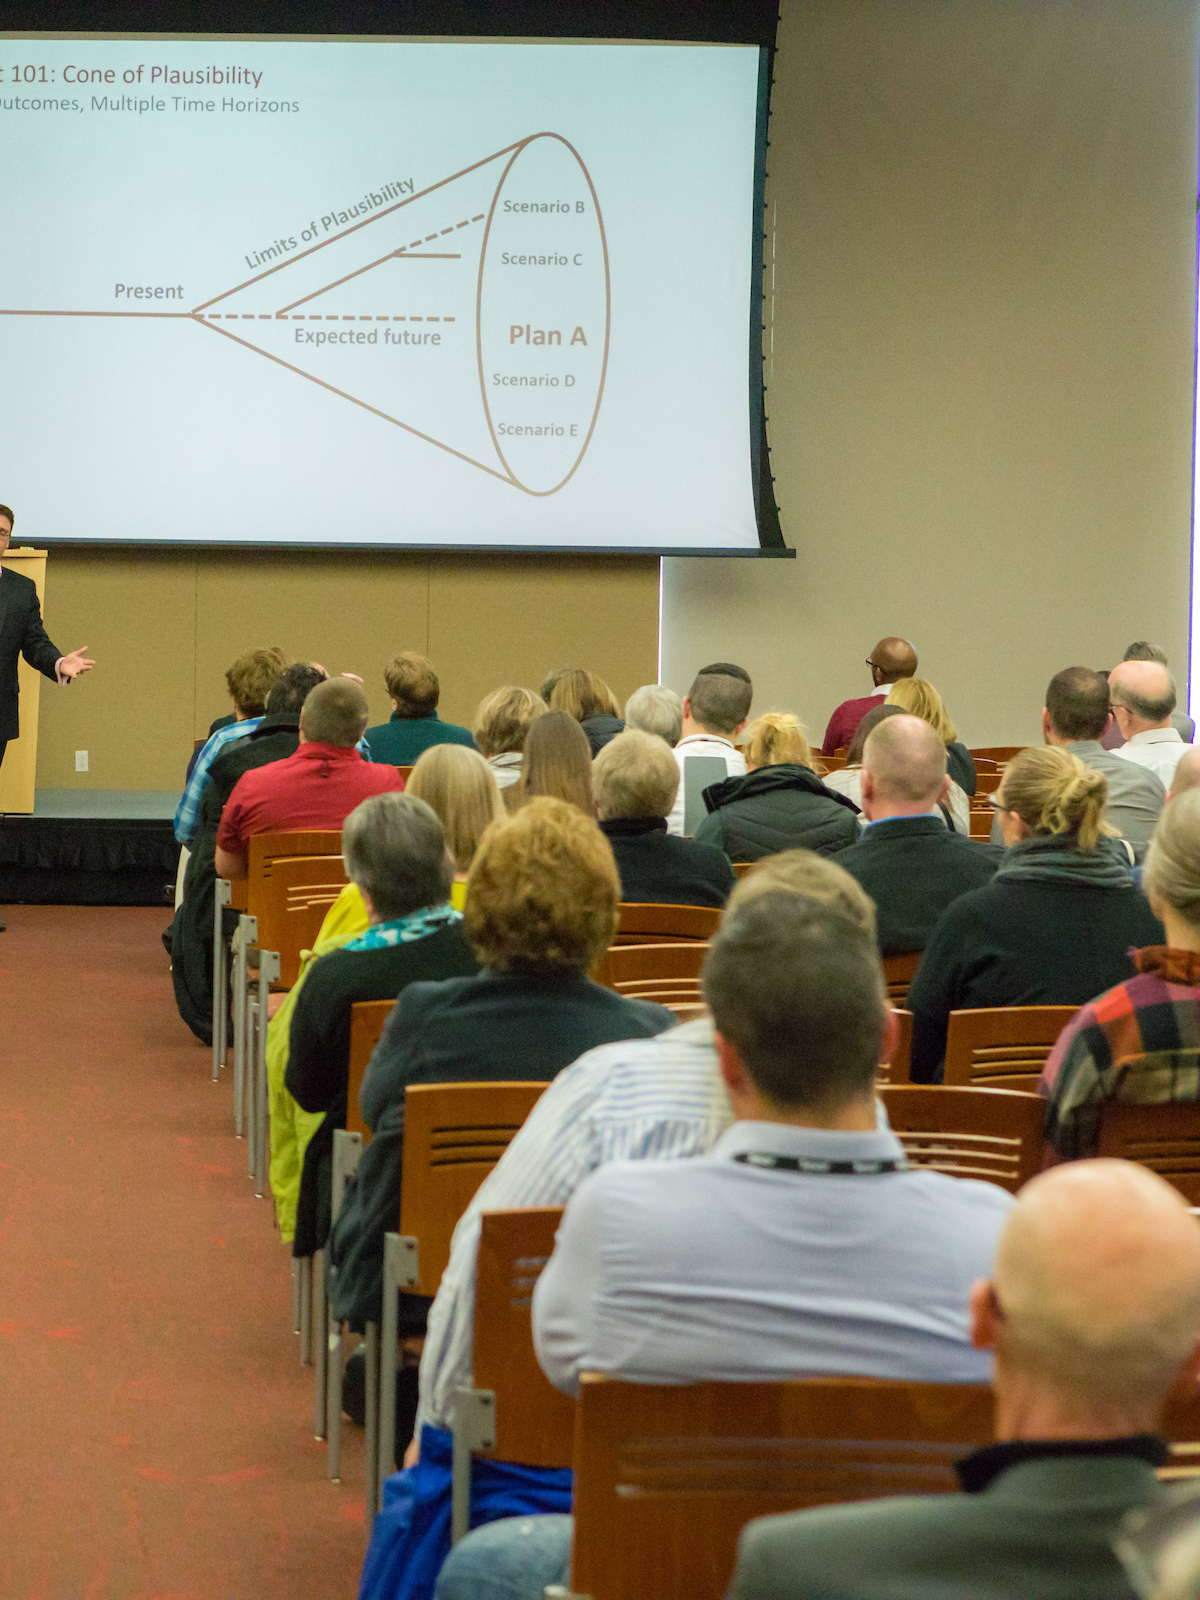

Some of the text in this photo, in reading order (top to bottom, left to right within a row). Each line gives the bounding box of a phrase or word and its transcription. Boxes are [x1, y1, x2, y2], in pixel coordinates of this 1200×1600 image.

[12, 65, 55, 83] 101:
[63, 65, 115, 83] Cone
[123, 64, 144, 83] of
[151, 65, 263, 89] Plausibility
[91, 95, 165, 114] Multiple
[171, 97, 215, 112] Time
[222, 97, 299, 112] Horizons
[504, 200, 585, 213] Scenario B
[245, 177, 415, 270] Limits of Plausibility
[502, 252, 582, 266] Scenario C
[115, 284, 184, 299] Present
[295, 328, 441, 347] Expected future
[510, 324, 587, 346] Plan A
[493, 373, 575, 387] Scenario D
[498, 423, 578, 437] Scenario E
